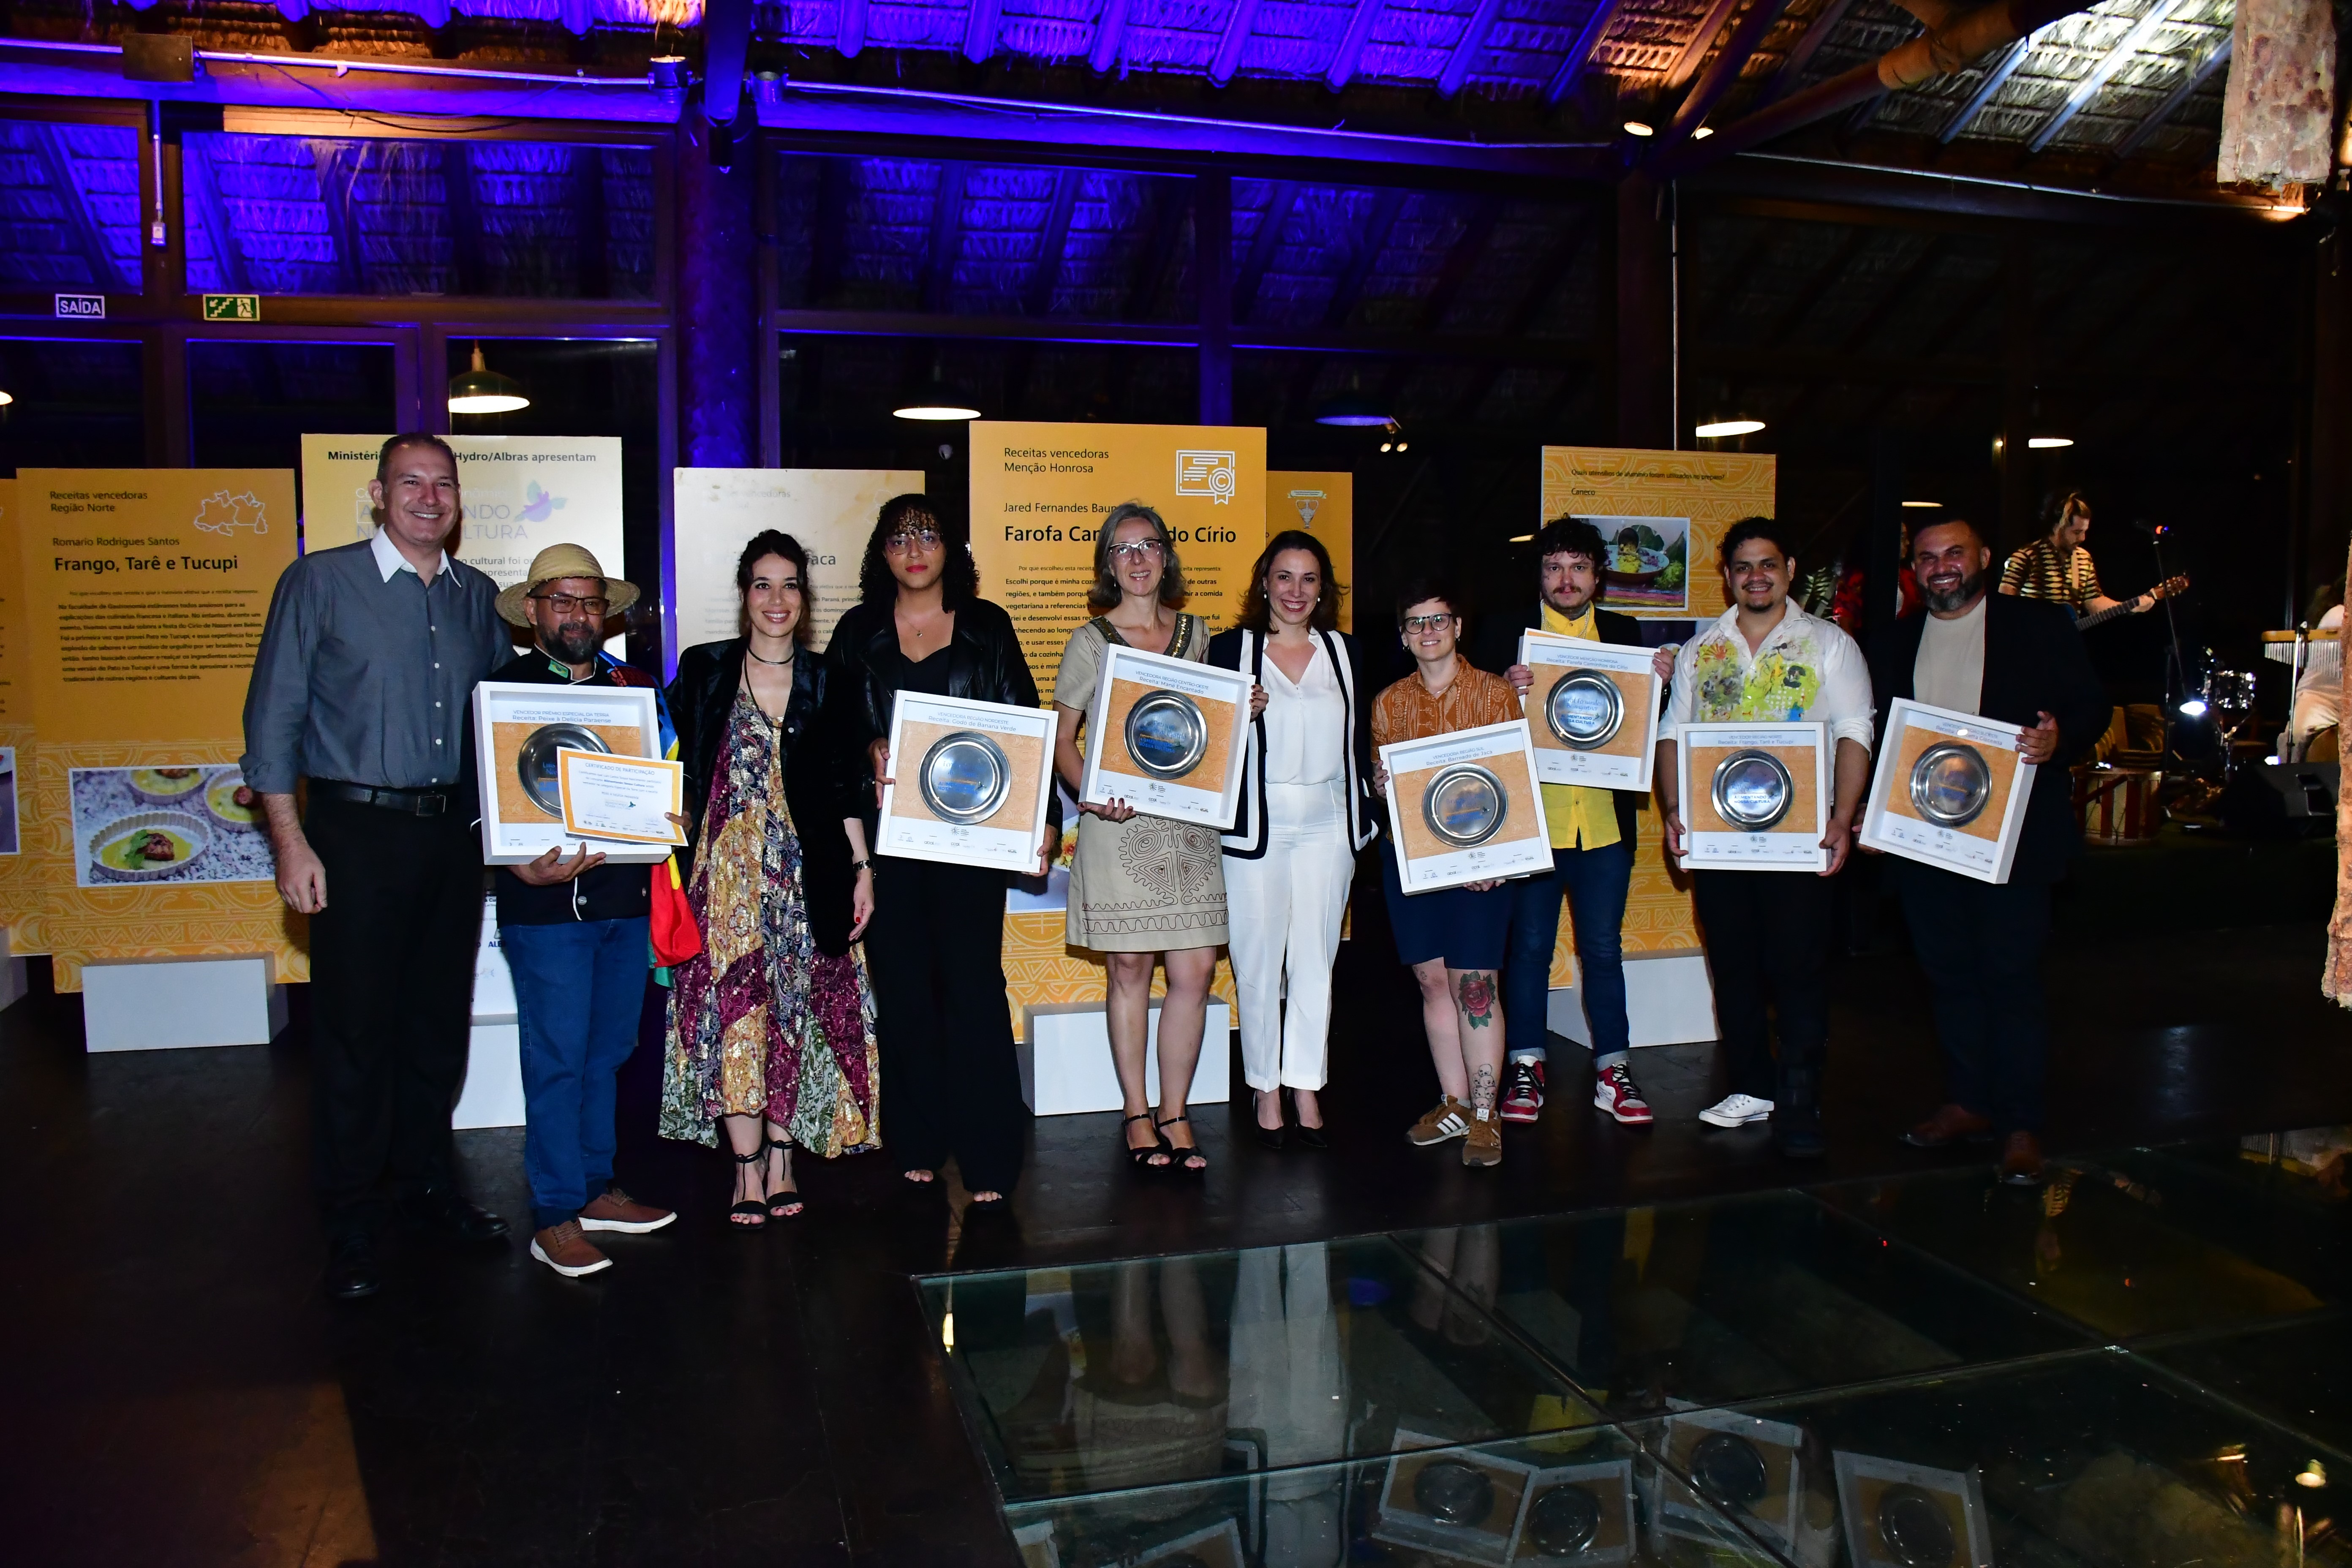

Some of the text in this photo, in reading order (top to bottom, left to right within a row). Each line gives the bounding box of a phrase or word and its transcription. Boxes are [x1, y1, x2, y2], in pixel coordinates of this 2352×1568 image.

[60, 297, 101, 315] SAÍDA
[328, 450, 596, 463] Ministéri Hydro/Albras apresentam
[1004, 447, 1109, 459] Receitas vencedoras
[1004, 463, 1094, 474] Menção Honrosa
[50, 490, 147, 500] Receitas vencedoras
[51, 503, 115, 513] Região Norte
[1004, 502, 1032, 513] Jared
[1035, 503, 1088, 513] Fernandes
[465, 525, 528, 539] LTURA
[1005, 526, 1063, 542] Farofa
[1195, 526, 1237, 543] Círio
[53, 536, 180, 547] Romario Rodrigues Santos
[54, 555, 238, 574] Frango, Tarê e Tucupi
[469, 557, 506, 565] cultural
[508, 557, 521, 565] foi
[1135, 671, 1209, 690] VENCEDORA REGIÃO CENTRO-OESTE
[1139, 677, 1204, 694] Receita: Mané Encantado
[937, 712, 966, 720] VENCEDORA
[977, 721, 999, 730] Banana
[1433, 751, 1459, 760] VENCEDORA
[1448, 753, 1472, 762] Barreado
